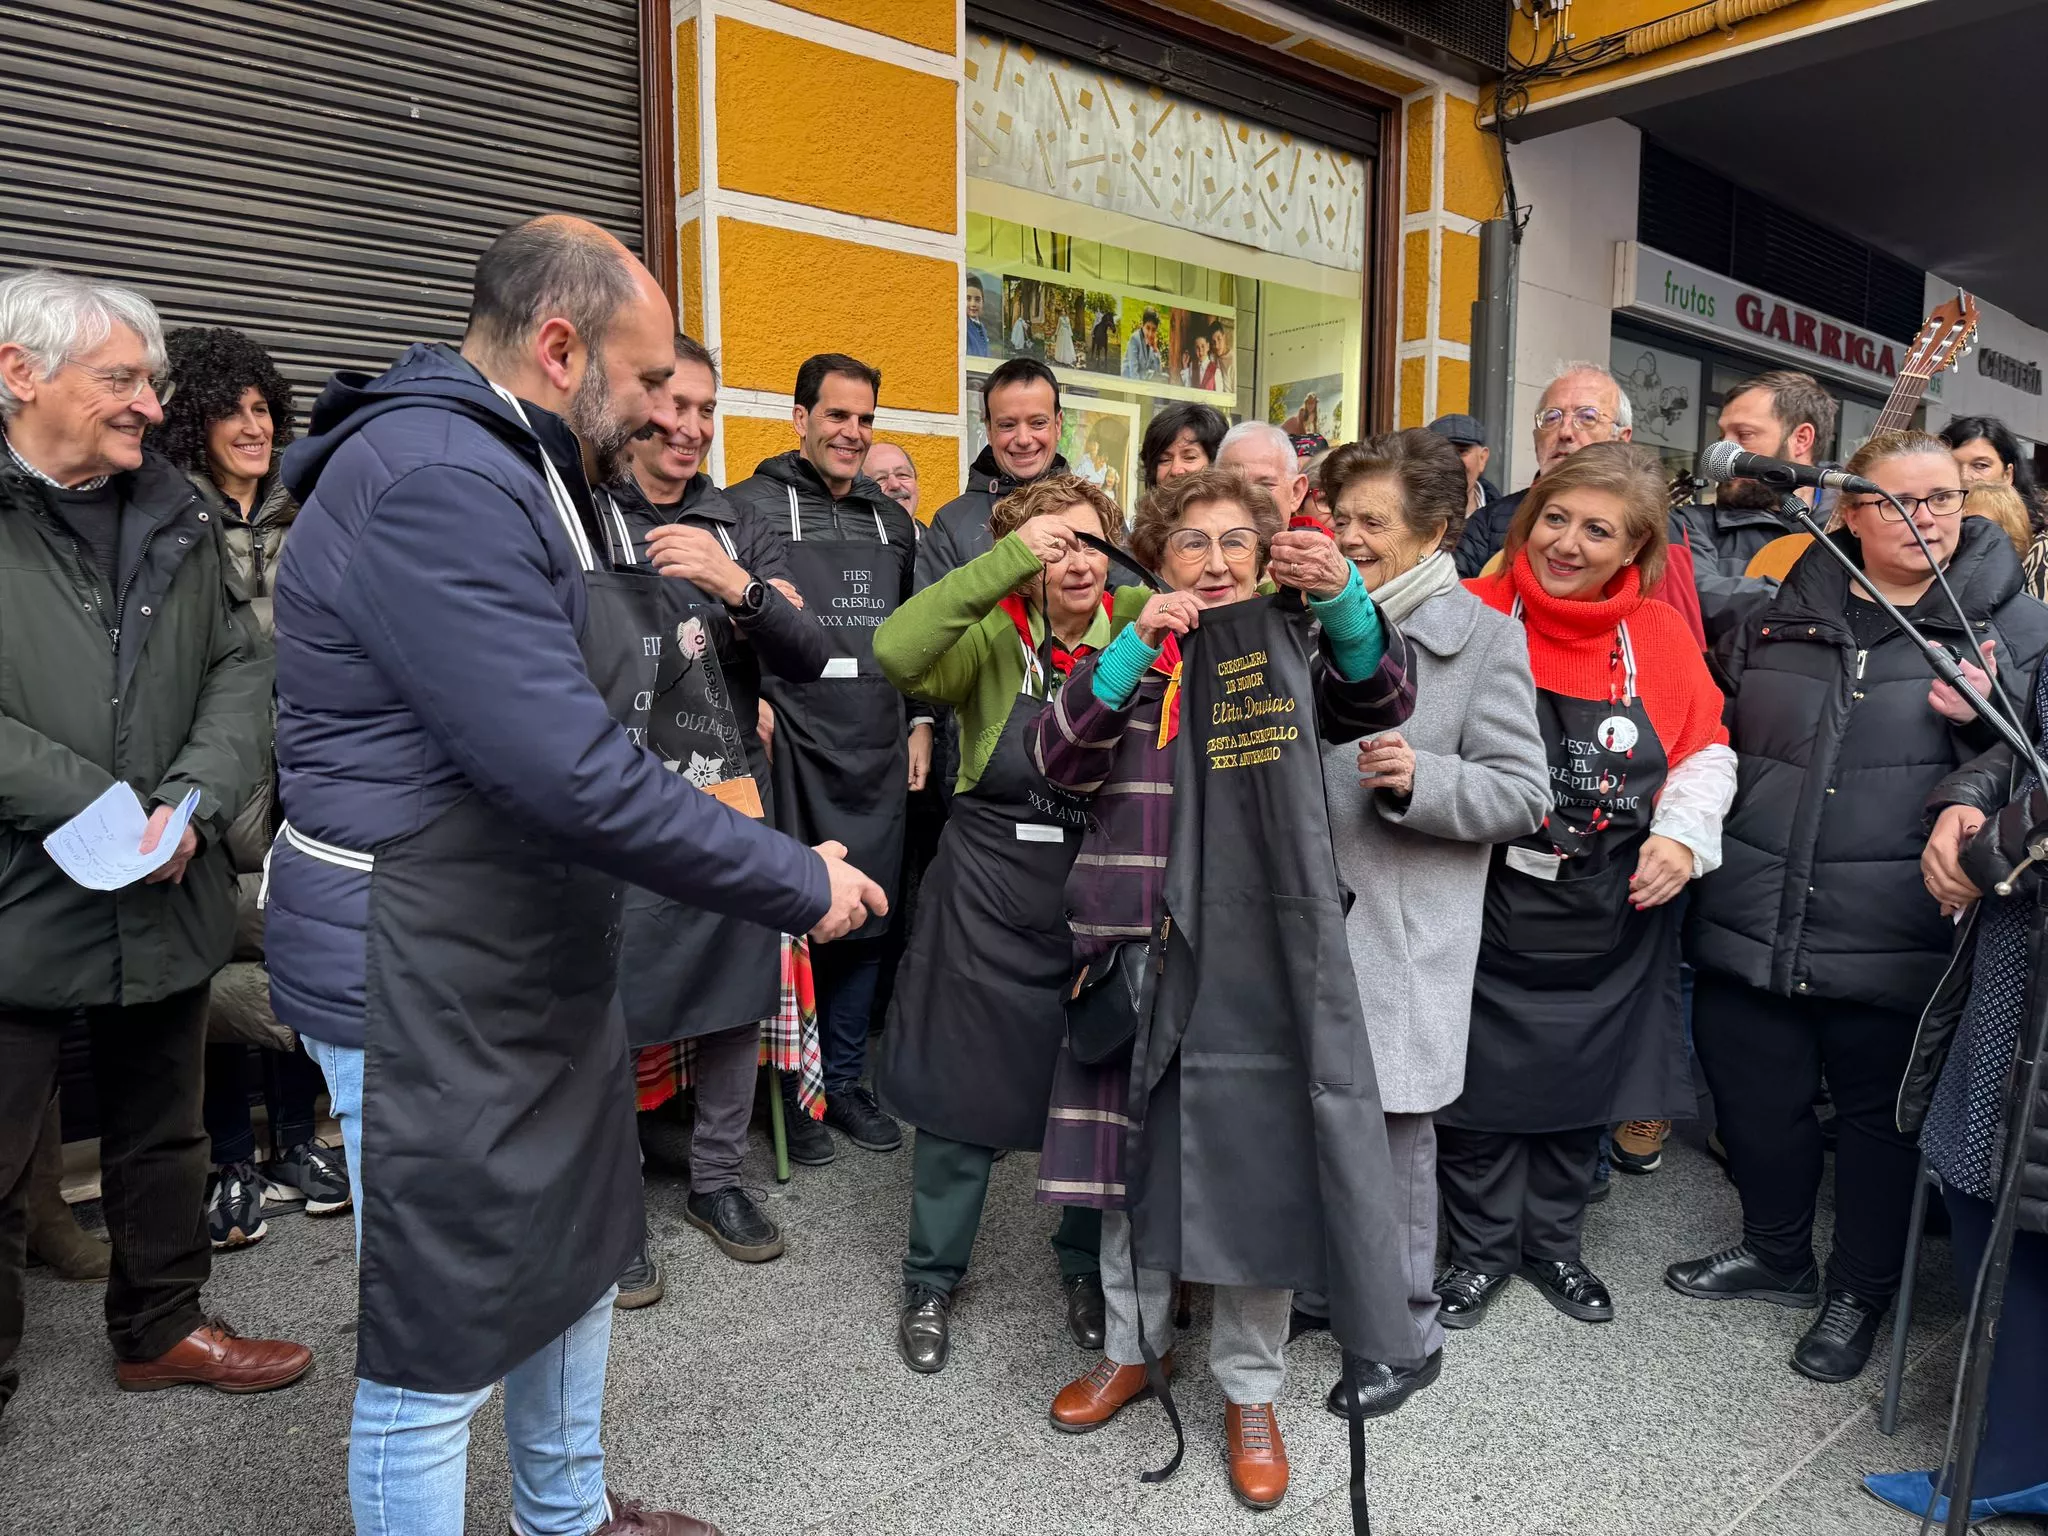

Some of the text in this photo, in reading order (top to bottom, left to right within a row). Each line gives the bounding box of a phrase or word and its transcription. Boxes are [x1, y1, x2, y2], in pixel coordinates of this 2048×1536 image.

[1664, 270, 1898, 379] frutas GARRIGA
[842, 570, 873, 582] FIEST
[852, 583, 871, 595] DE
[831, 597, 886, 609] CRESPLLO
[816, 615, 844, 627] XXX
[1211, 754, 1238, 770] XXX
[1027, 789, 1056, 815] XXX
[1551, 789, 1640, 811] NIVERSARIO
